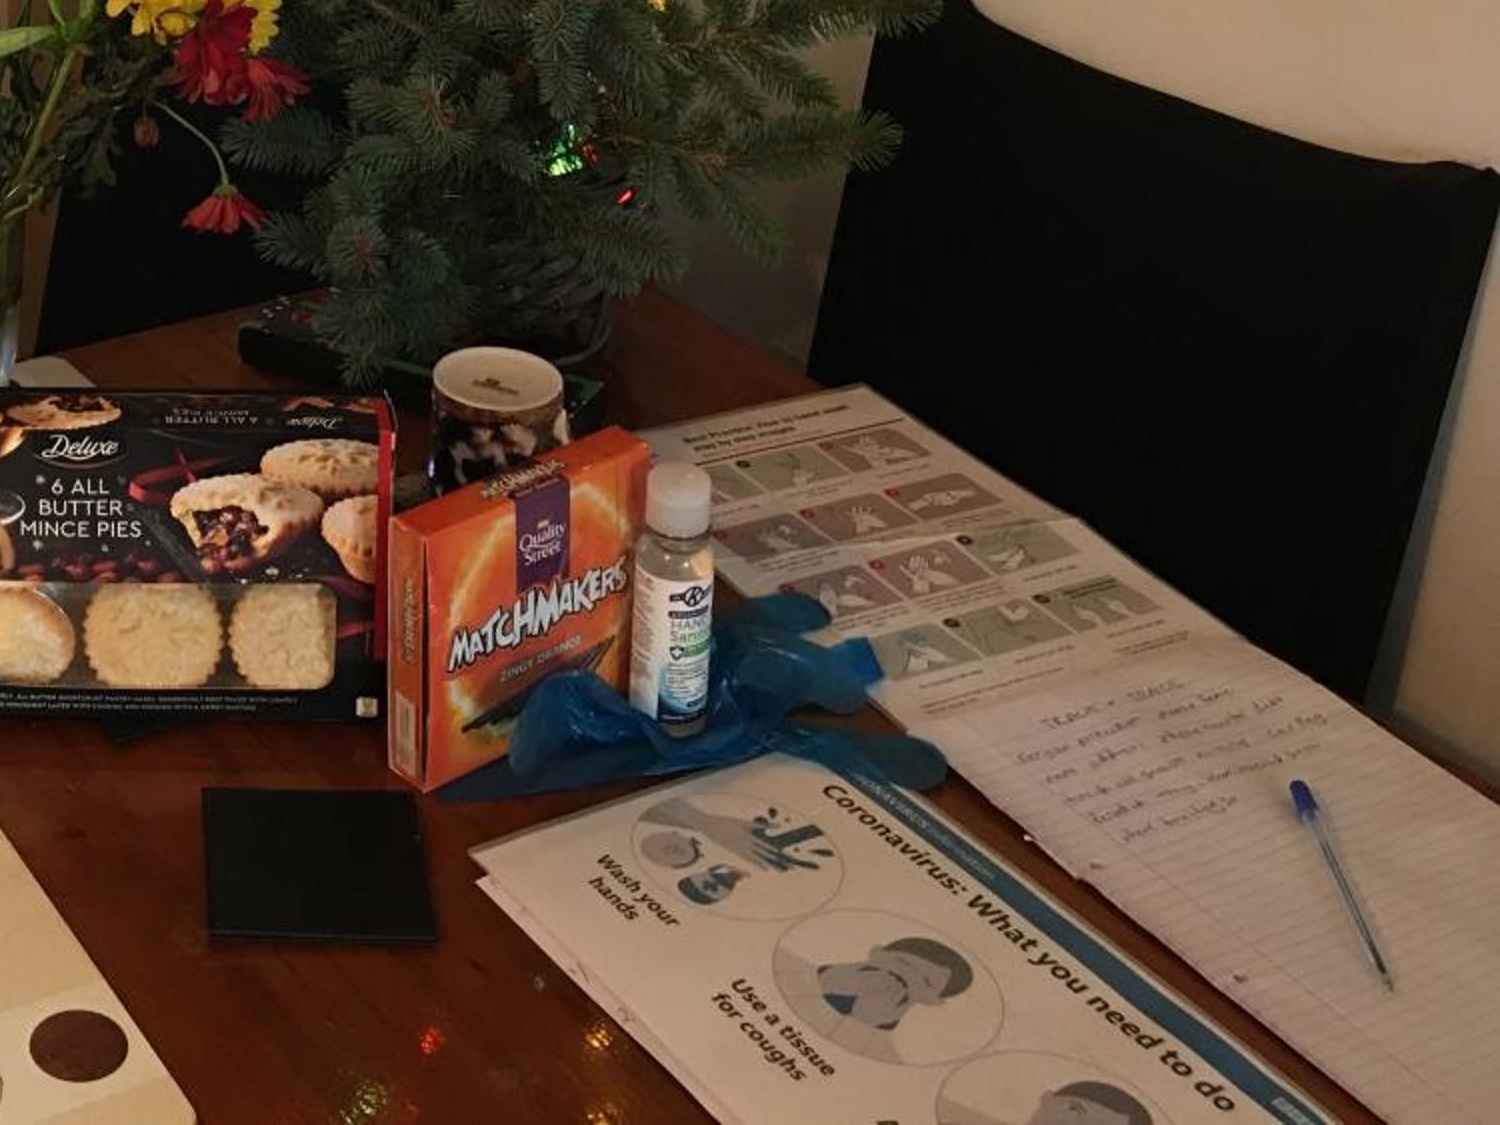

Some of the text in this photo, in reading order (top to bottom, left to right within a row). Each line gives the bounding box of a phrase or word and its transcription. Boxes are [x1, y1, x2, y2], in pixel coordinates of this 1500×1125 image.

[42, 434, 119, 461] Deluxe
[51, 478, 110, 495] 6 ALL
[39, 499, 123, 516] BUTTER
[20, 521, 142, 538] MINCE PIES
[519, 522, 566, 551] Quality
[524, 543, 561, 566] Street
[448, 556, 629, 673] MATCHMAKERS
[588, 876, 639, 921] hands
[597, 853, 681, 928] Wash your
[823, 783, 968, 894] Coronavirus:
[967, 892, 1040, 953] What
[1028, 950, 1088, 995] you
[1087, 995, 1164, 1051] need
[1159, 1045, 1192, 1078] to
[1194, 1079, 1236, 1113] do
[711, 991, 808, 1082] for coughs
[731, 977, 836, 1077] Use a tissue
